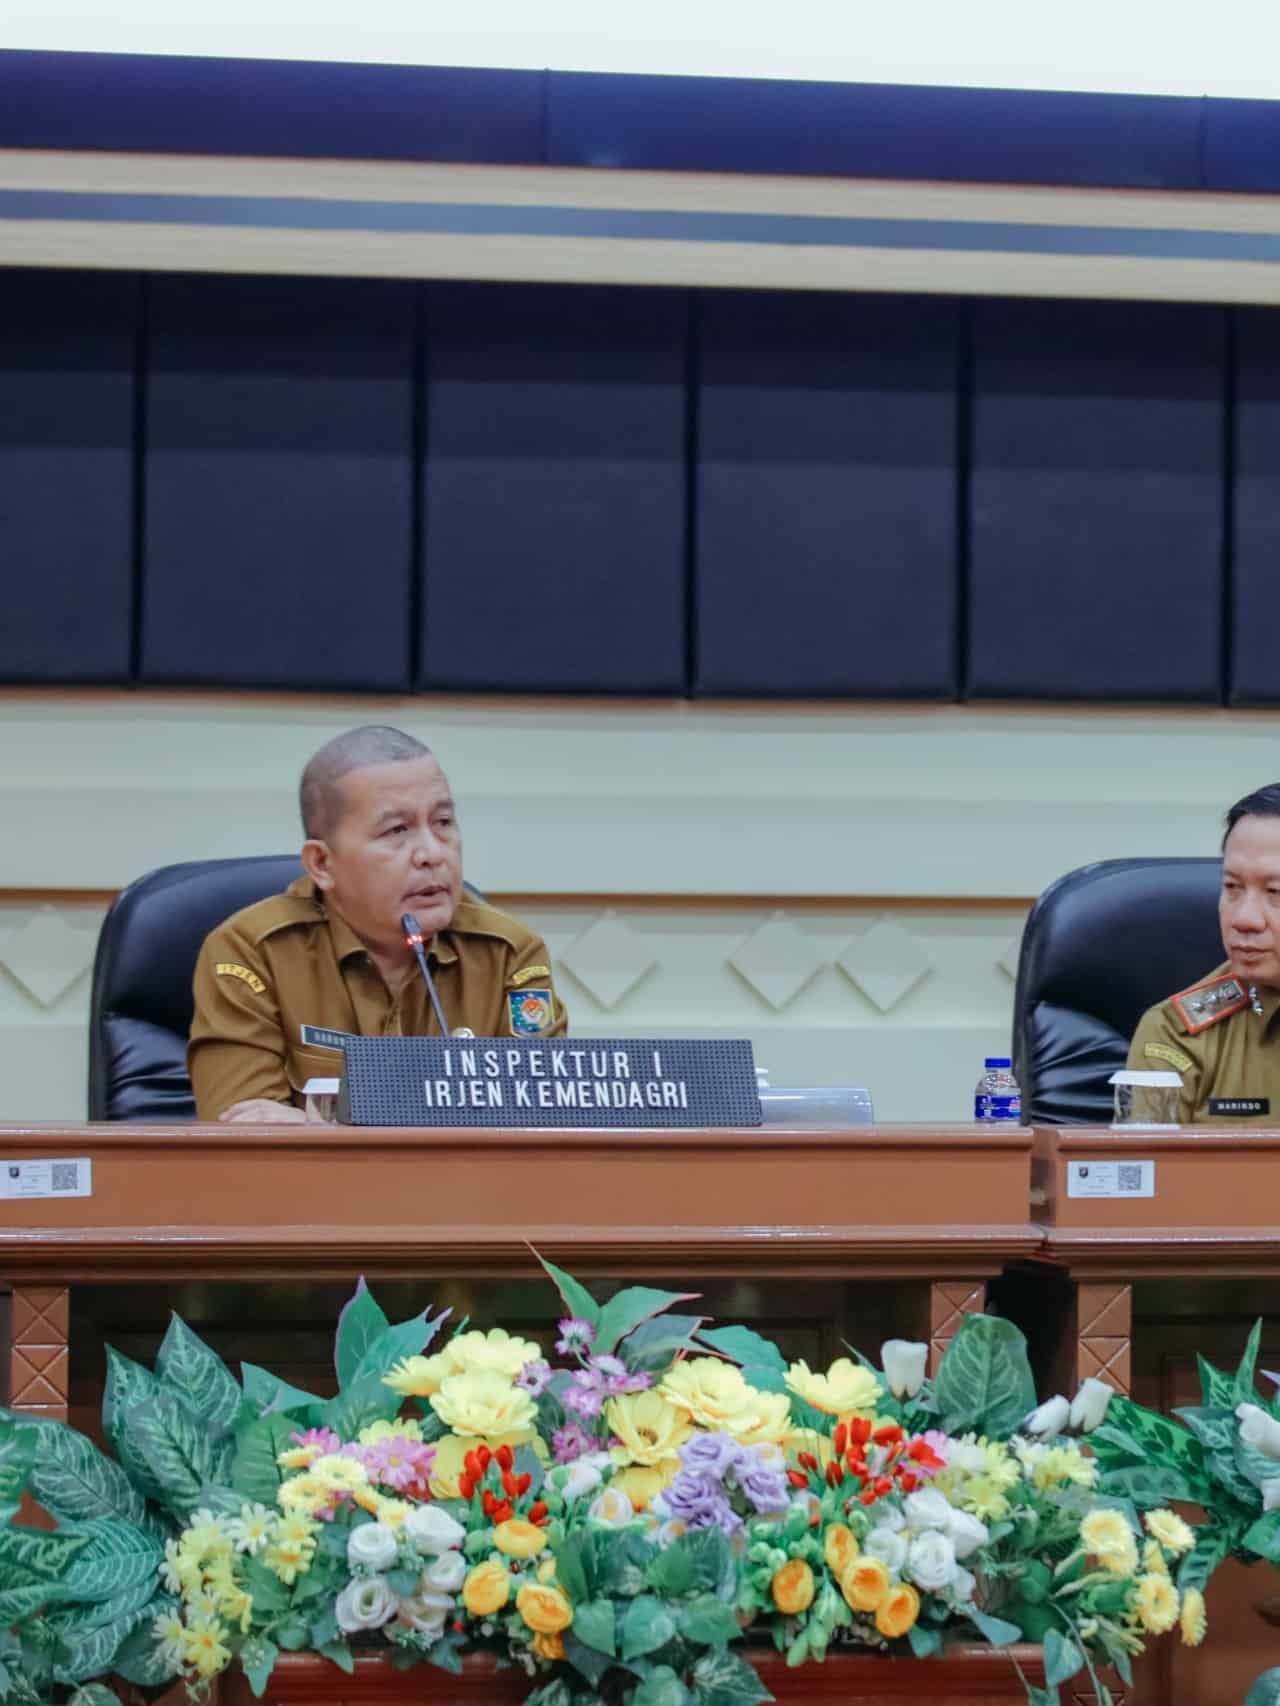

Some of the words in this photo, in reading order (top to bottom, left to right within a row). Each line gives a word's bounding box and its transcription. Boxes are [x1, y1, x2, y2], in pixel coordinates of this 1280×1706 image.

[443, 1050, 630, 1078] INSPEKTUR
[654, 1051, 663, 1078] I
[424, 1080, 503, 1107] IRJEN
[515, 1081, 688, 1108] KEMENDAGRI
